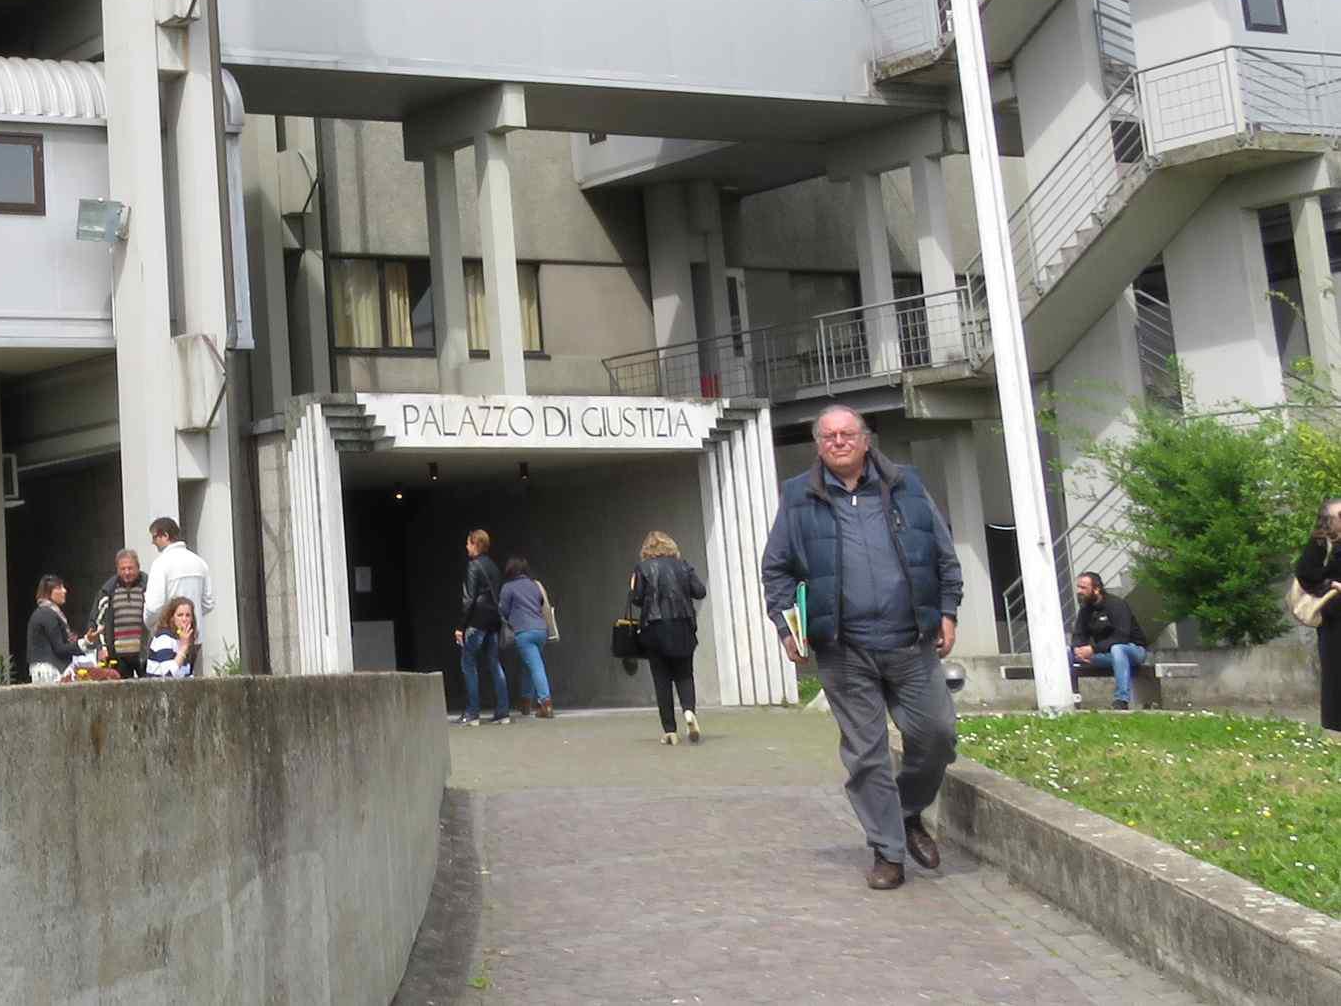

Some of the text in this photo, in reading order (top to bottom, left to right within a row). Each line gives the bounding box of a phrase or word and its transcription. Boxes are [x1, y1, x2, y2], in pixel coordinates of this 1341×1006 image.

[402, 404, 694, 438] PALAZZO DI GIUSTIZIA
